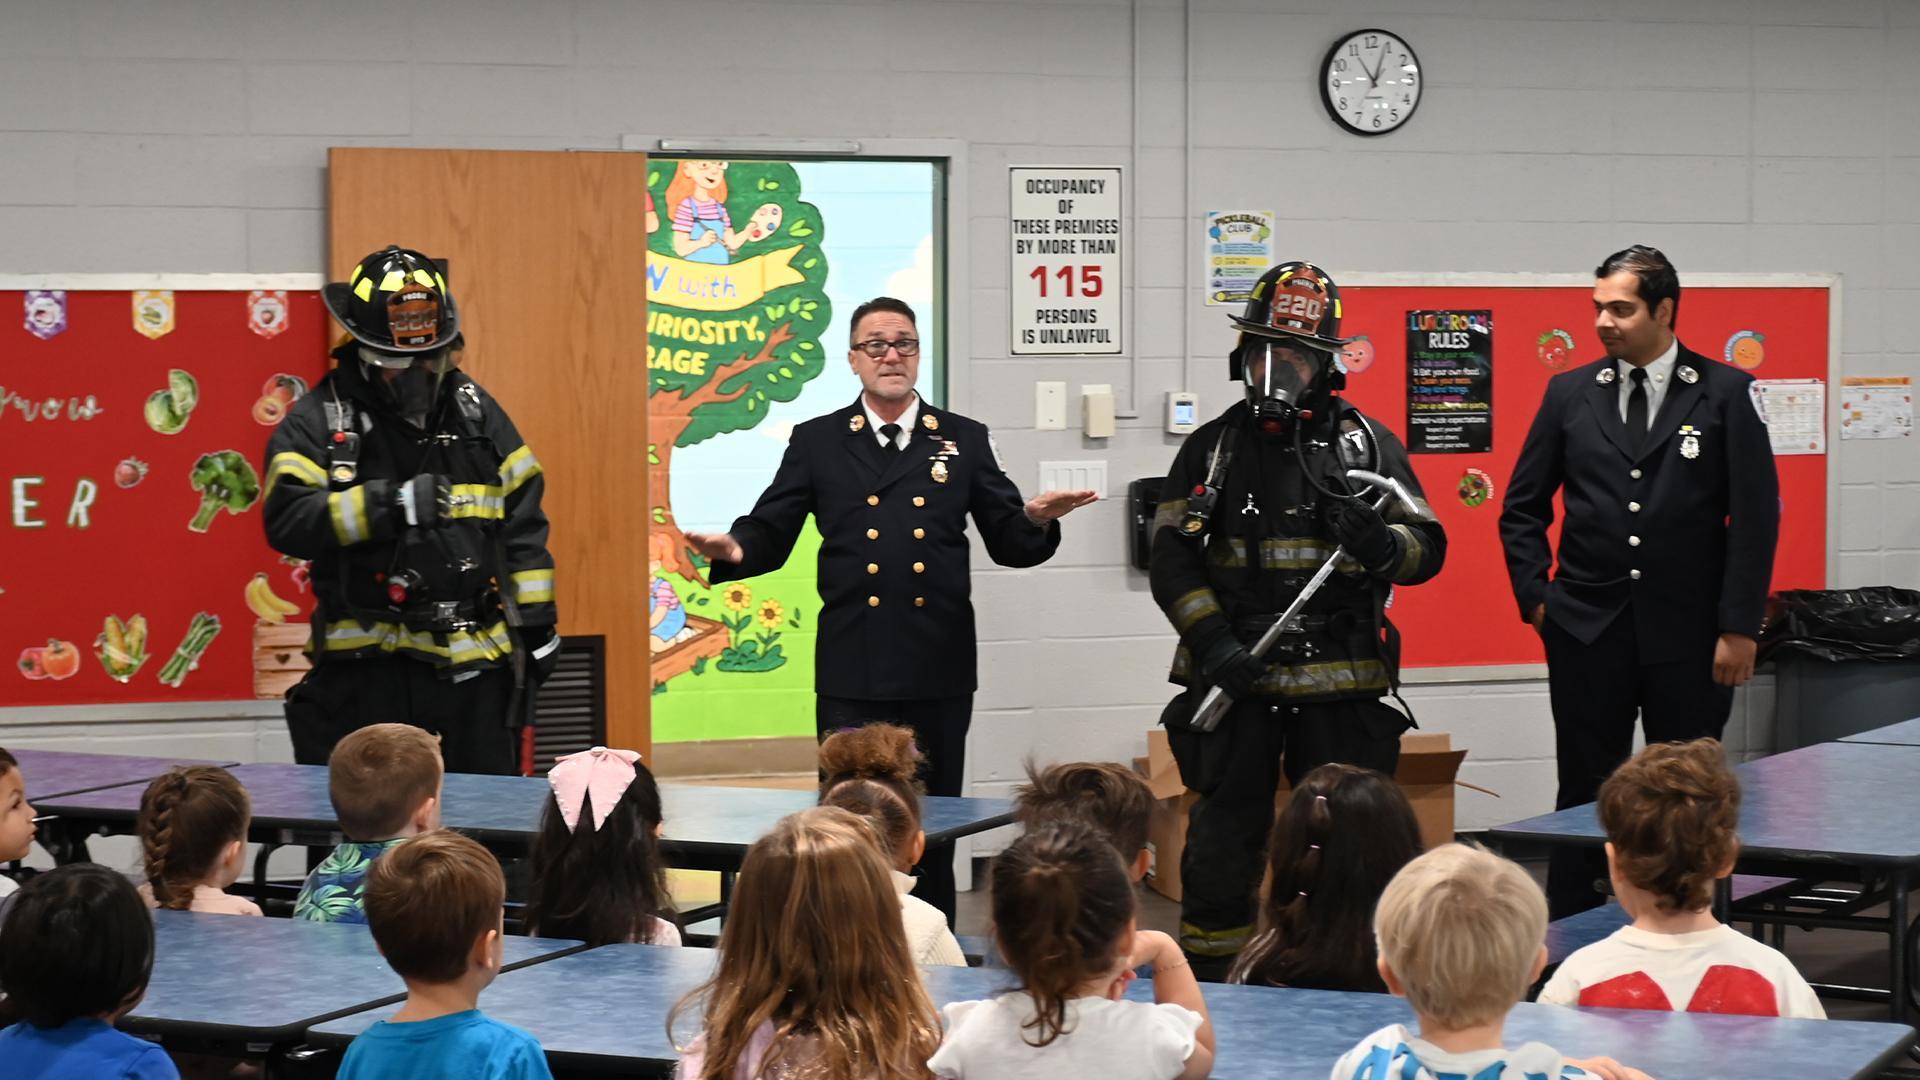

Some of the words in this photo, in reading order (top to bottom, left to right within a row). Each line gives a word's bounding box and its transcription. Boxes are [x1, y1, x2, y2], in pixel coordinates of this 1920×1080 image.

[1365, 35, 1378, 49] 12
[1385, 41, 1392, 54] 1
[1349, 44, 1359, 57] 11
[1334, 58, 1347, 72] 10
[1400, 54, 1408, 67] 2
[1332, 79, 1341, 91] 9
[1339, 97, 1348, 110] 8
[1402, 93, 1410, 105] 4
[1355, 112, 1362, 125] 7
[1373, 114, 1381, 128] 6
[1390, 109, 1398, 122] 5
[1026, 179, 1105, 194] OCCUPANCY
[1058, 199, 1074, 214] OF
[1013, 219, 1050, 234] THESE
[1055, 219, 1118, 234] PREMISES
[1227, 224, 1252, 233] CLUB
[1016, 239, 1034, 254] BY
[1038, 239, 1076, 254] MORE
[1081, 239, 1116, 254] THAN
[679, 274, 737, 298] with
[1030, 265, 1103, 297] 115
[1277, 294, 1320, 320] 220
[1037, 309, 1097, 324] PERSONS
[1022, 329, 1035, 344] IS
[1040, 329, 1111, 344] UNLAWFUL
[1428, 332, 1470, 349] RULES
